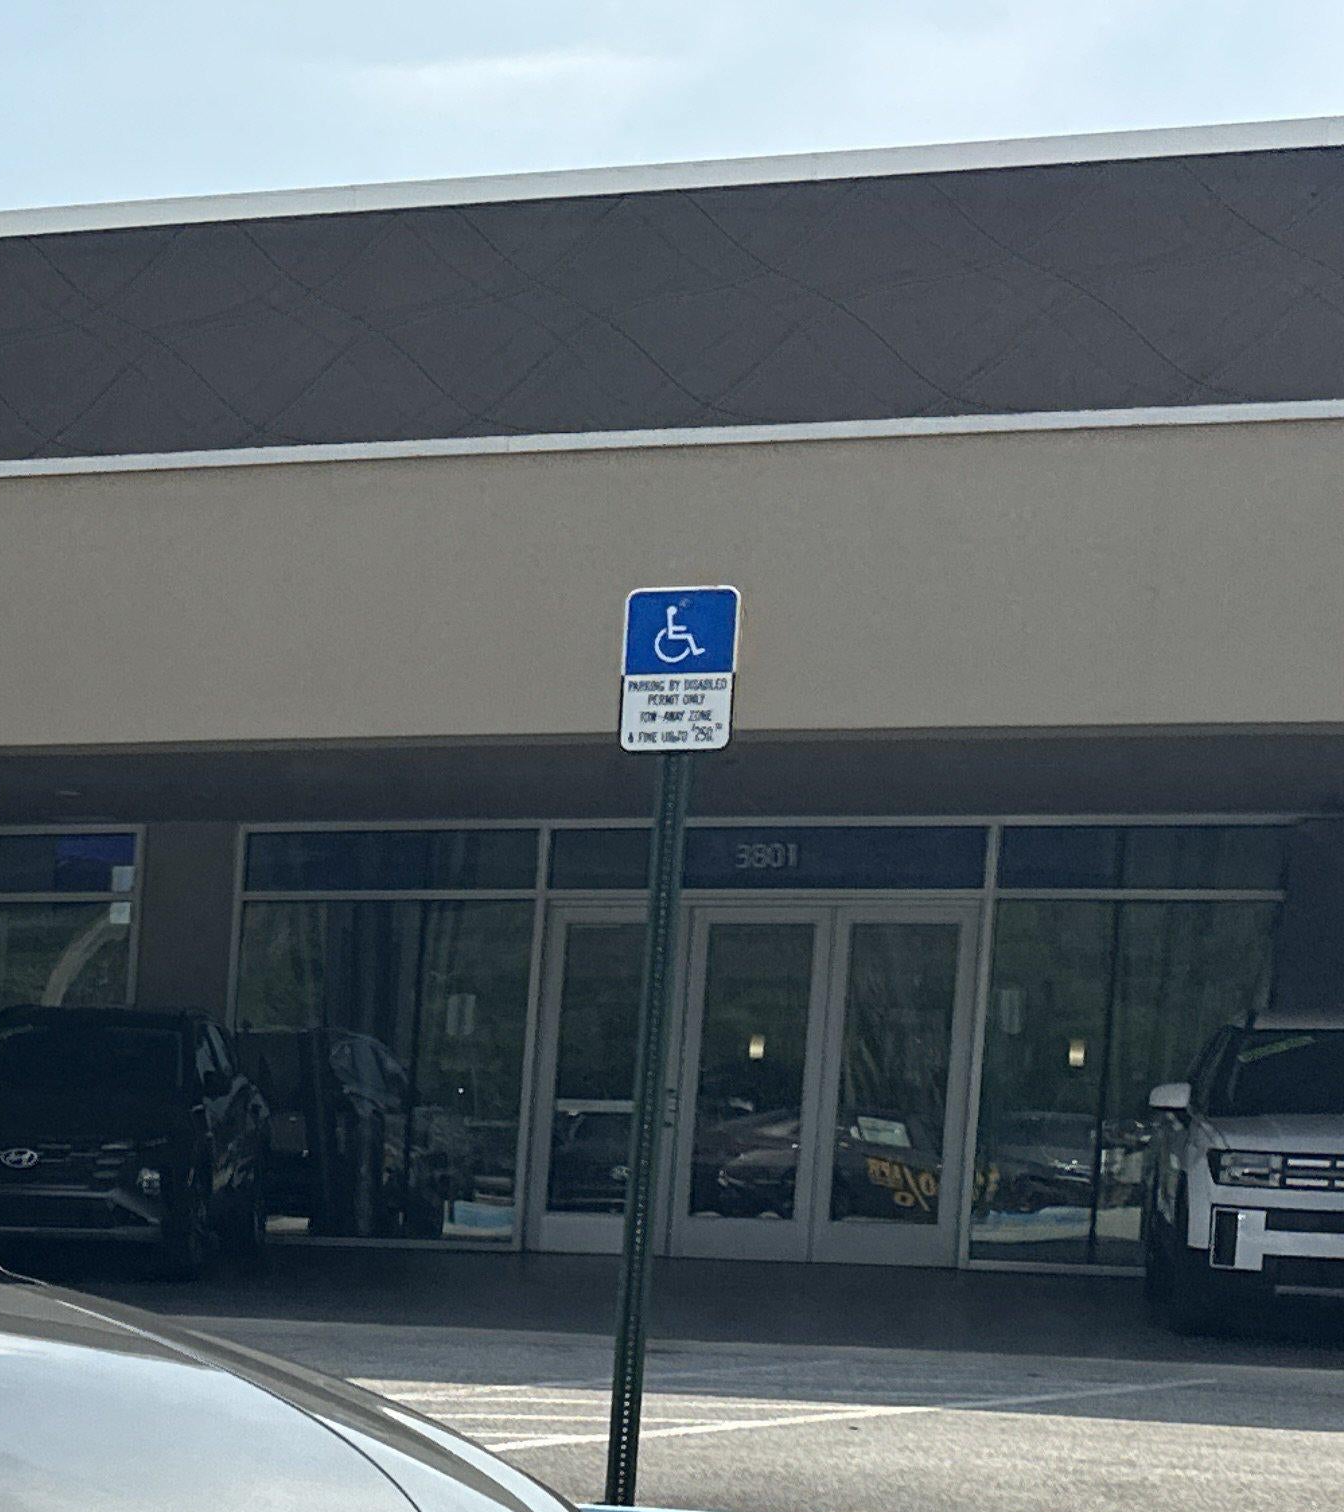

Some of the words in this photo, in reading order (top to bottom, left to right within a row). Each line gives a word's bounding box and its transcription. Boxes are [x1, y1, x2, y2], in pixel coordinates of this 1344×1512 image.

[628, 680, 665, 692] PARKING
[669, 679, 680, 691] BY
[684, 678, 727, 691] DISABLED
[648, 693, 679, 705] PERMIT
[683, 693, 705, 705] ONLY
[735, 843, 798, 868] 3801
